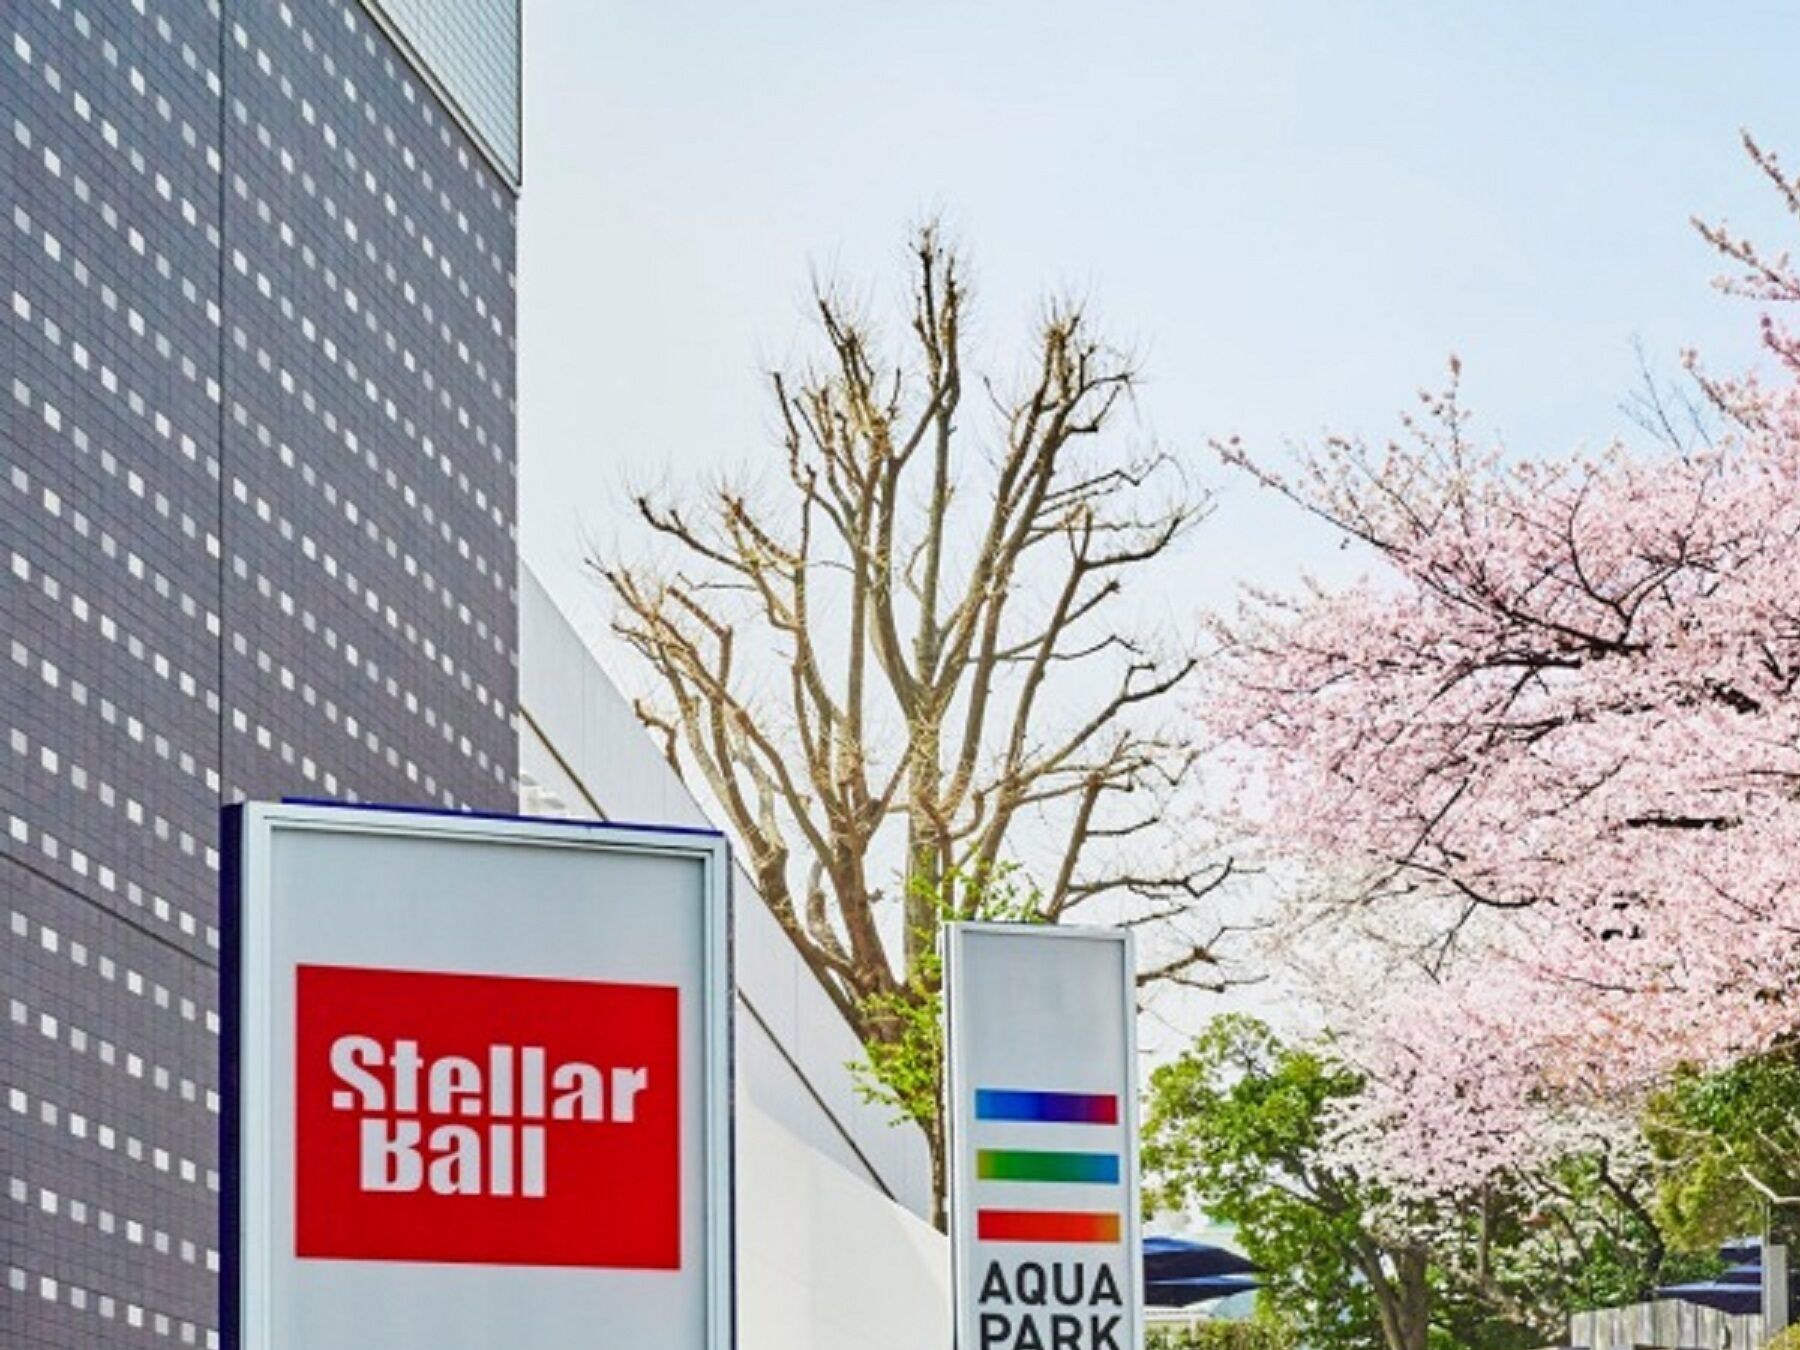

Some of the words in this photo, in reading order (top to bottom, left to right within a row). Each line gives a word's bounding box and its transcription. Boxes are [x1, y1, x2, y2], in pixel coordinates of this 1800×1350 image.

[329, 1034, 648, 1123] Stellar
[360, 1118, 547, 1198] Ball
[977, 1260, 1124, 1307] AQUA
